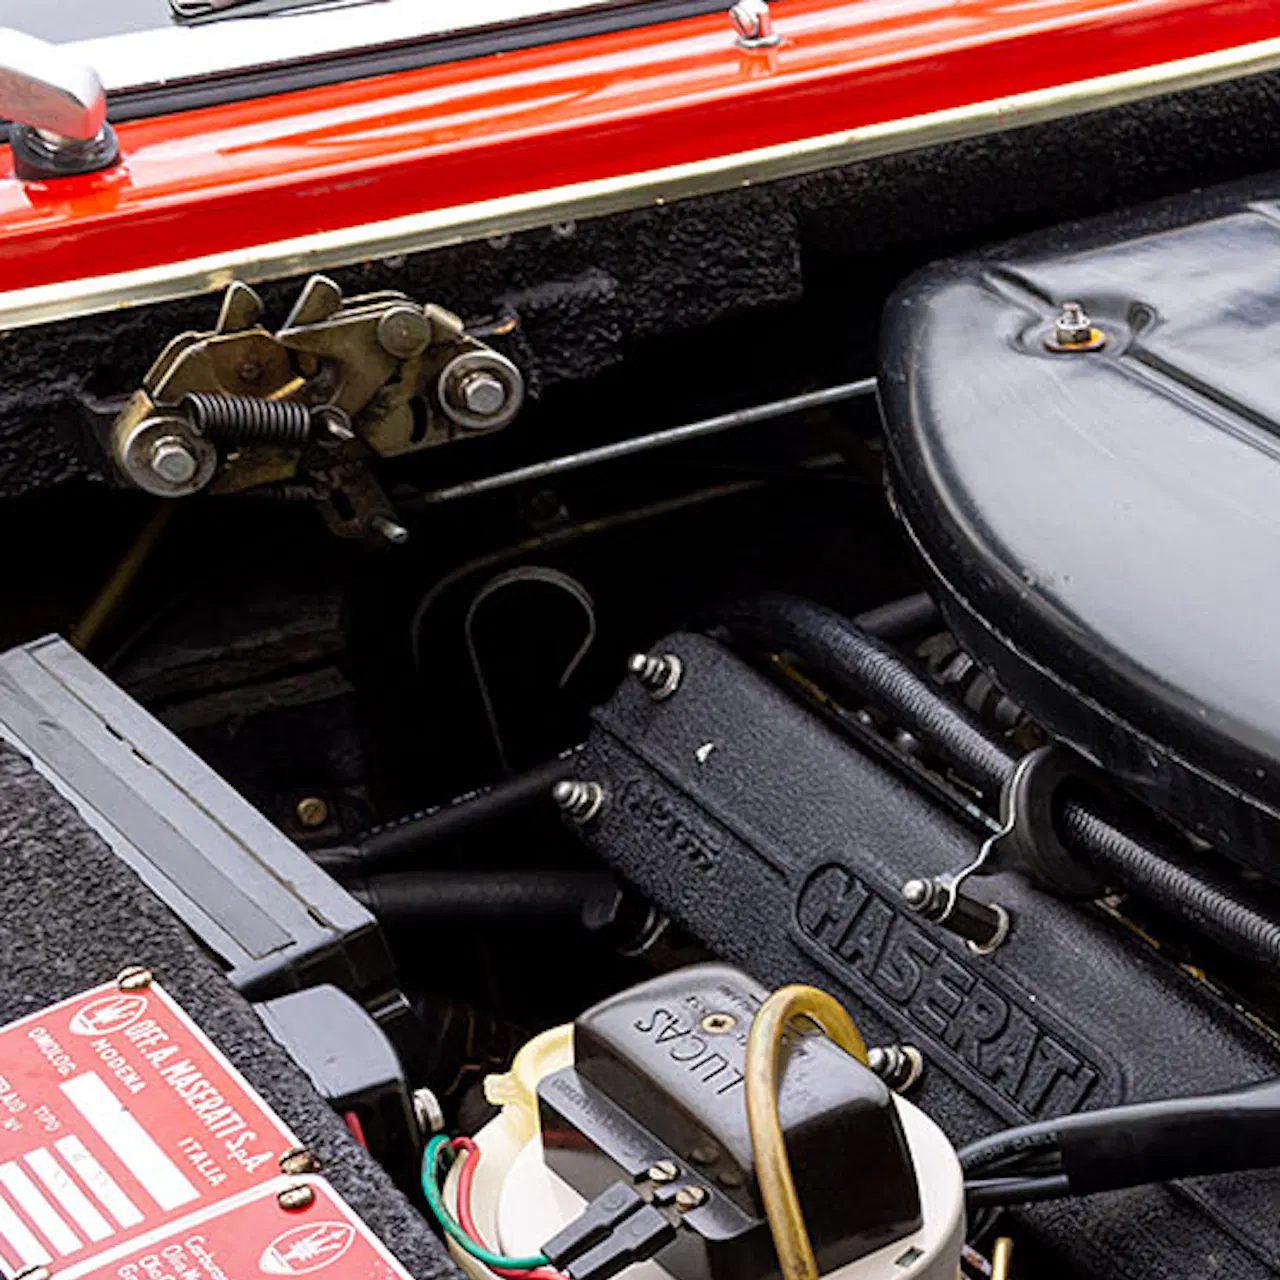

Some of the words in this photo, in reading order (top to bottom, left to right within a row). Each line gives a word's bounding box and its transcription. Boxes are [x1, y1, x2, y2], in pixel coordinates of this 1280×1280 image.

[803, 866, 1102, 1115] MASERATI
[160, 1059, 246, 1139] MASERATI
[634, 1007, 745, 1095] LUCAS
[91, 1038, 146, 1094] MODENA
[178, 1137, 227, 1186] ITALIA
